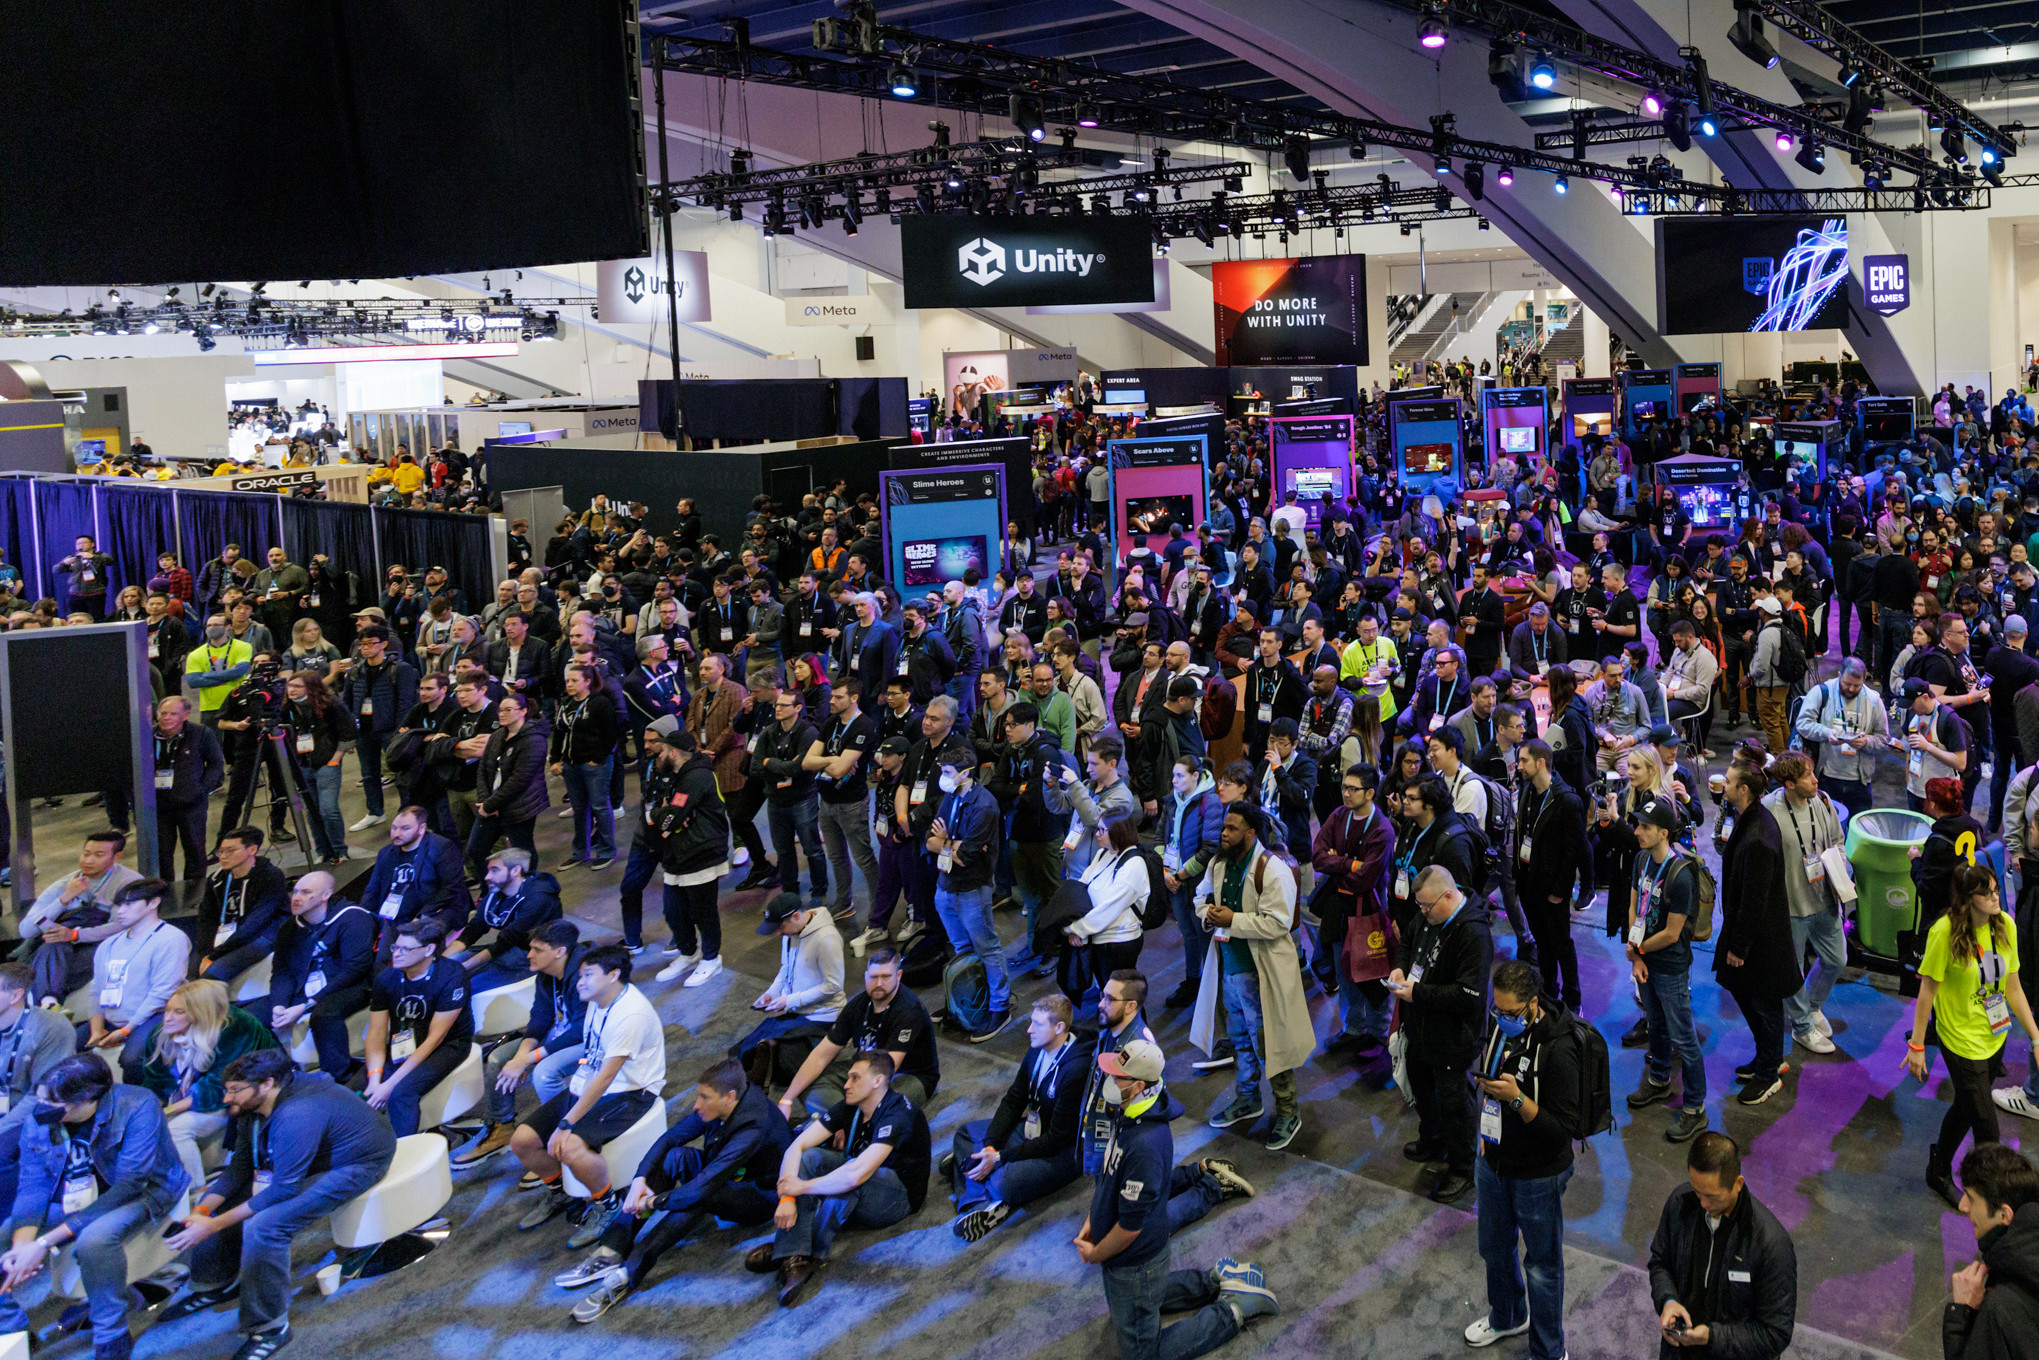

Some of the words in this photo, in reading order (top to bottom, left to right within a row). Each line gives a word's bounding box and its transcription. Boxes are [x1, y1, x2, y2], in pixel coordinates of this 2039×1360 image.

[1747, 261, 1770, 279] EPIC
[1869, 265, 1904, 291] EPIC
[651, 276, 684, 299] Unty
[1254, 299, 1274, 312] DO
[1278, 297, 1318, 311] MORE
[1870, 294, 1905, 304] GAMES
[823, 305, 857, 316] Meta
[1246, 315, 1282, 328] WITH
[1286, 313, 1327, 326] UNITY
[1049, 352, 1072, 362] Meta
[608, 416, 637, 428] Meta
[940, 449, 969, 457] IMMERSIVE
[971, 446, 1005, 455] CHARACTERS
[1153, 446, 1175, 454] Above
[949, 452, 990, 460] ENVIRONMENTS
[1697, 466, 1727, 474] Domination
[235, 472, 315, 491] ORACLE
[912, 481, 935, 489] Slime
[936, 479, 965, 488] Heroes
[904, 544, 937, 553] SLIME
[905, 550, 938, 560] HEROES
[1485, 1103, 1500, 1115] GDC
